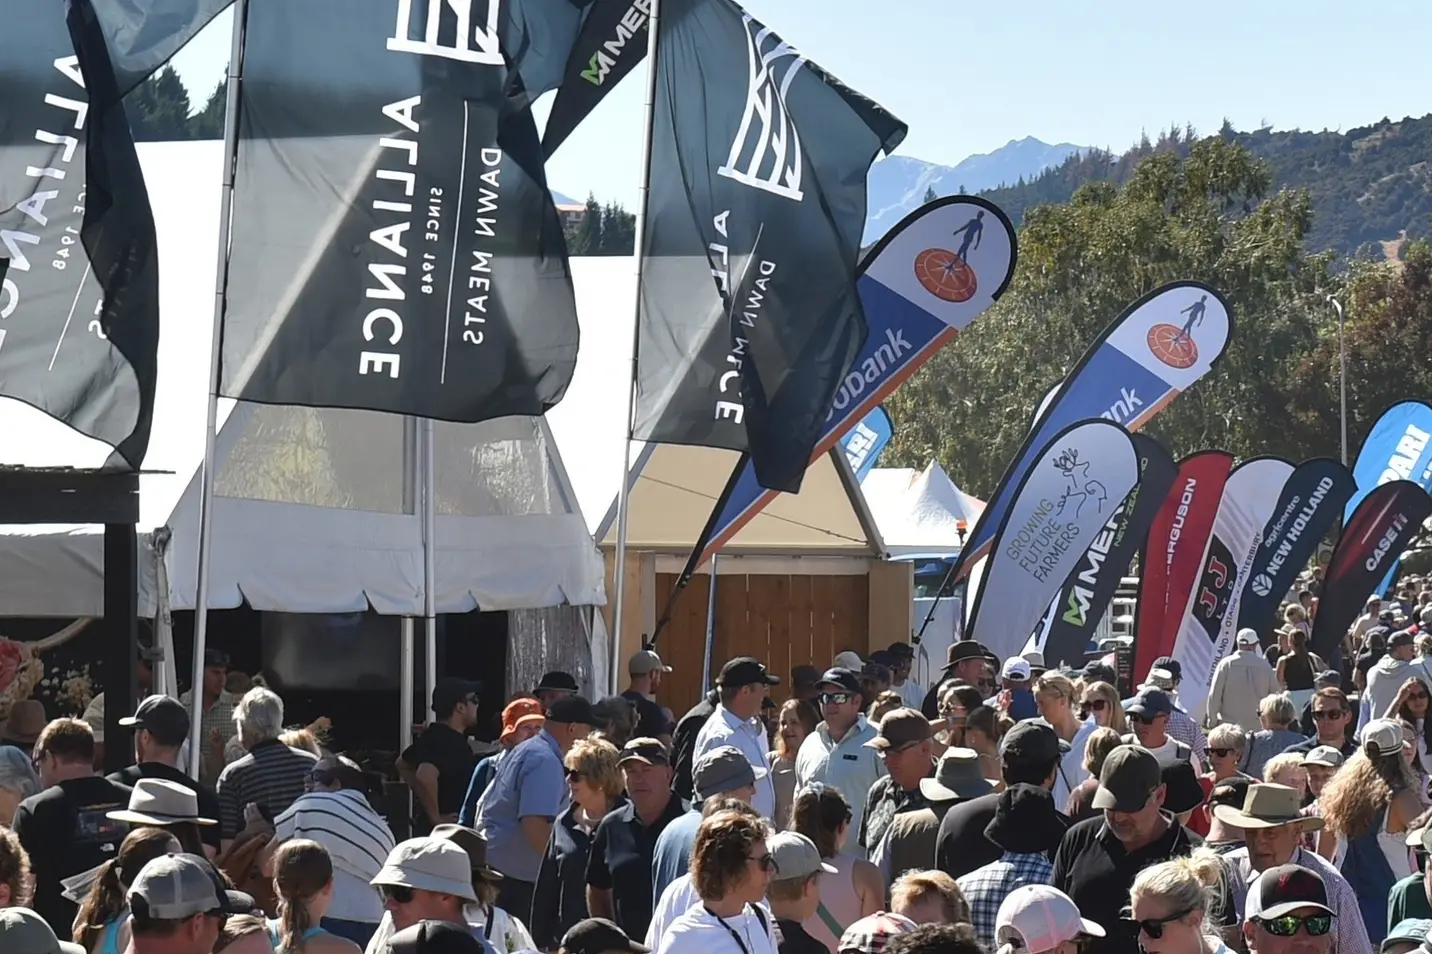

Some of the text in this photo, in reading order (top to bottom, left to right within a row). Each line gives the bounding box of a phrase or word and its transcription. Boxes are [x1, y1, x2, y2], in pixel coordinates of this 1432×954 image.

[1006, 498, 1055, 562] GROWING
[1018, 517, 1062, 573] FUTURE
[1032, 522, 1081, 584] FARMERS
[1114, 519, 1130, 547] NEW
[1266, 475, 1335, 576] NEW HOLLAND
[1365, 527, 1399, 573] CASE
